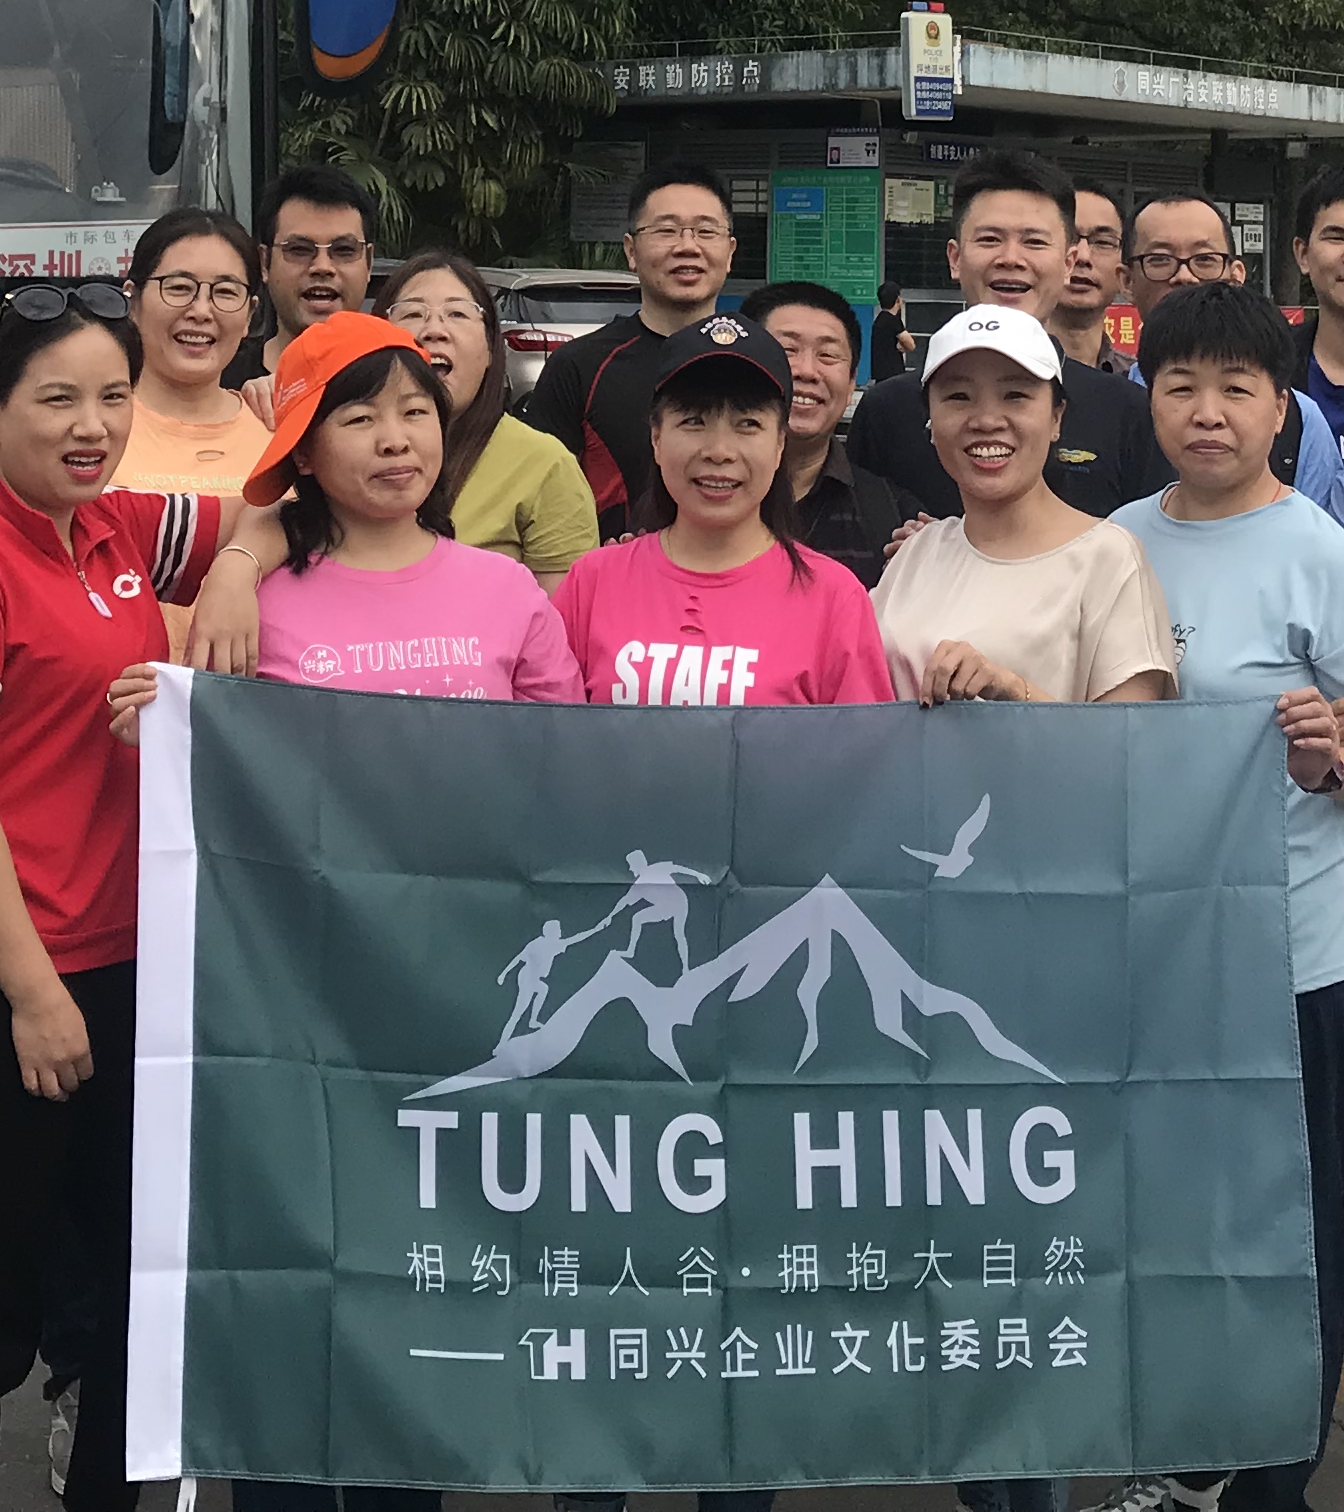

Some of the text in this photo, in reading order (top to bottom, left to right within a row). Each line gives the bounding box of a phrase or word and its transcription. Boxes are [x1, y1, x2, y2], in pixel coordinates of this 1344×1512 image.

[1136, 70, 1279, 110] 同兴厂治安联勤防控点
[968, 319, 1001, 333] OG
[347, 637, 483, 674] TUNGHING
[611, 640, 759, 706] STAFF
[397, 1105, 1078, 1215] TUNG HING
[608, 1316, 1090, 1381] 同兴企业文化委员会
